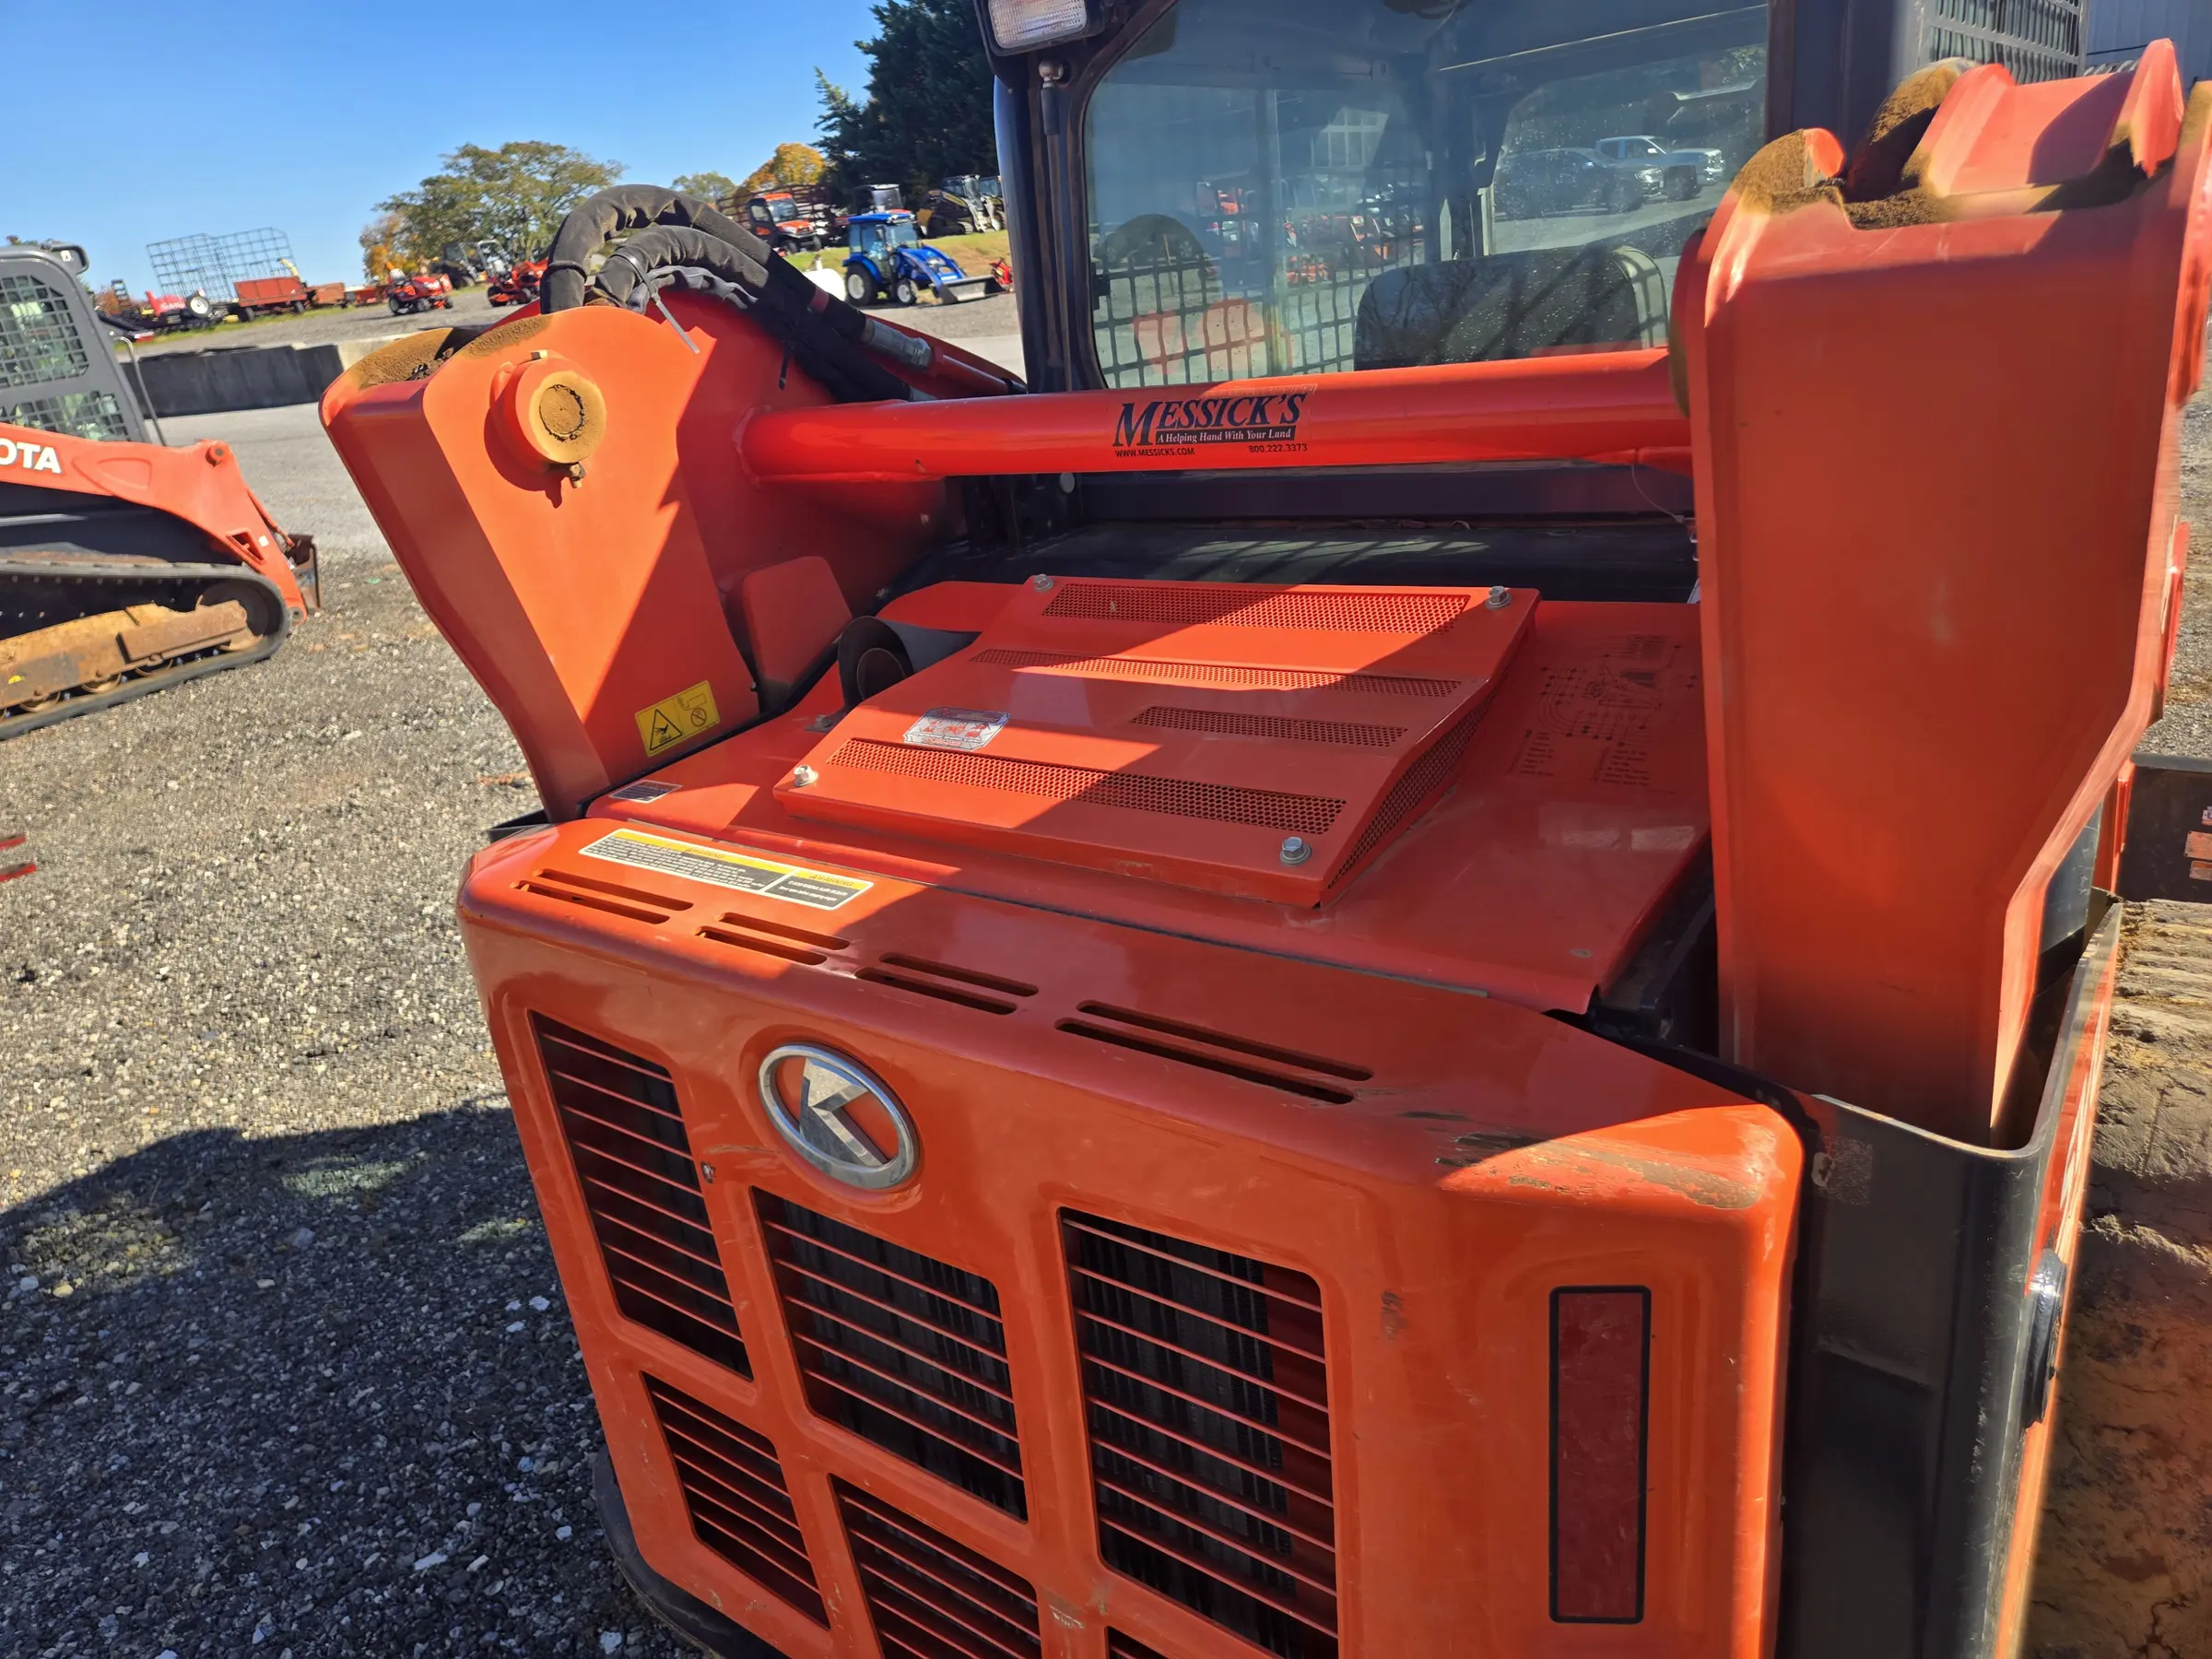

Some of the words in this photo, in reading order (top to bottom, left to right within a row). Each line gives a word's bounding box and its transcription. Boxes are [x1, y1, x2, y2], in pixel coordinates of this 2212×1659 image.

[1112, 393, 1308, 447] MESSICK'S
[1158, 433, 1164, 443] A
[1166, 433, 1197, 444] Helping
[1199, 431, 1222, 441] Hand
[1225, 430, 1244, 441] With
[1247, 429, 1266, 440] Your
[1268, 428, 1291, 439] Land
[1115, 447, 1195, 458] WWW.MESSICKS.COM
[1248, 443, 1308, 453] 800.222.3373
